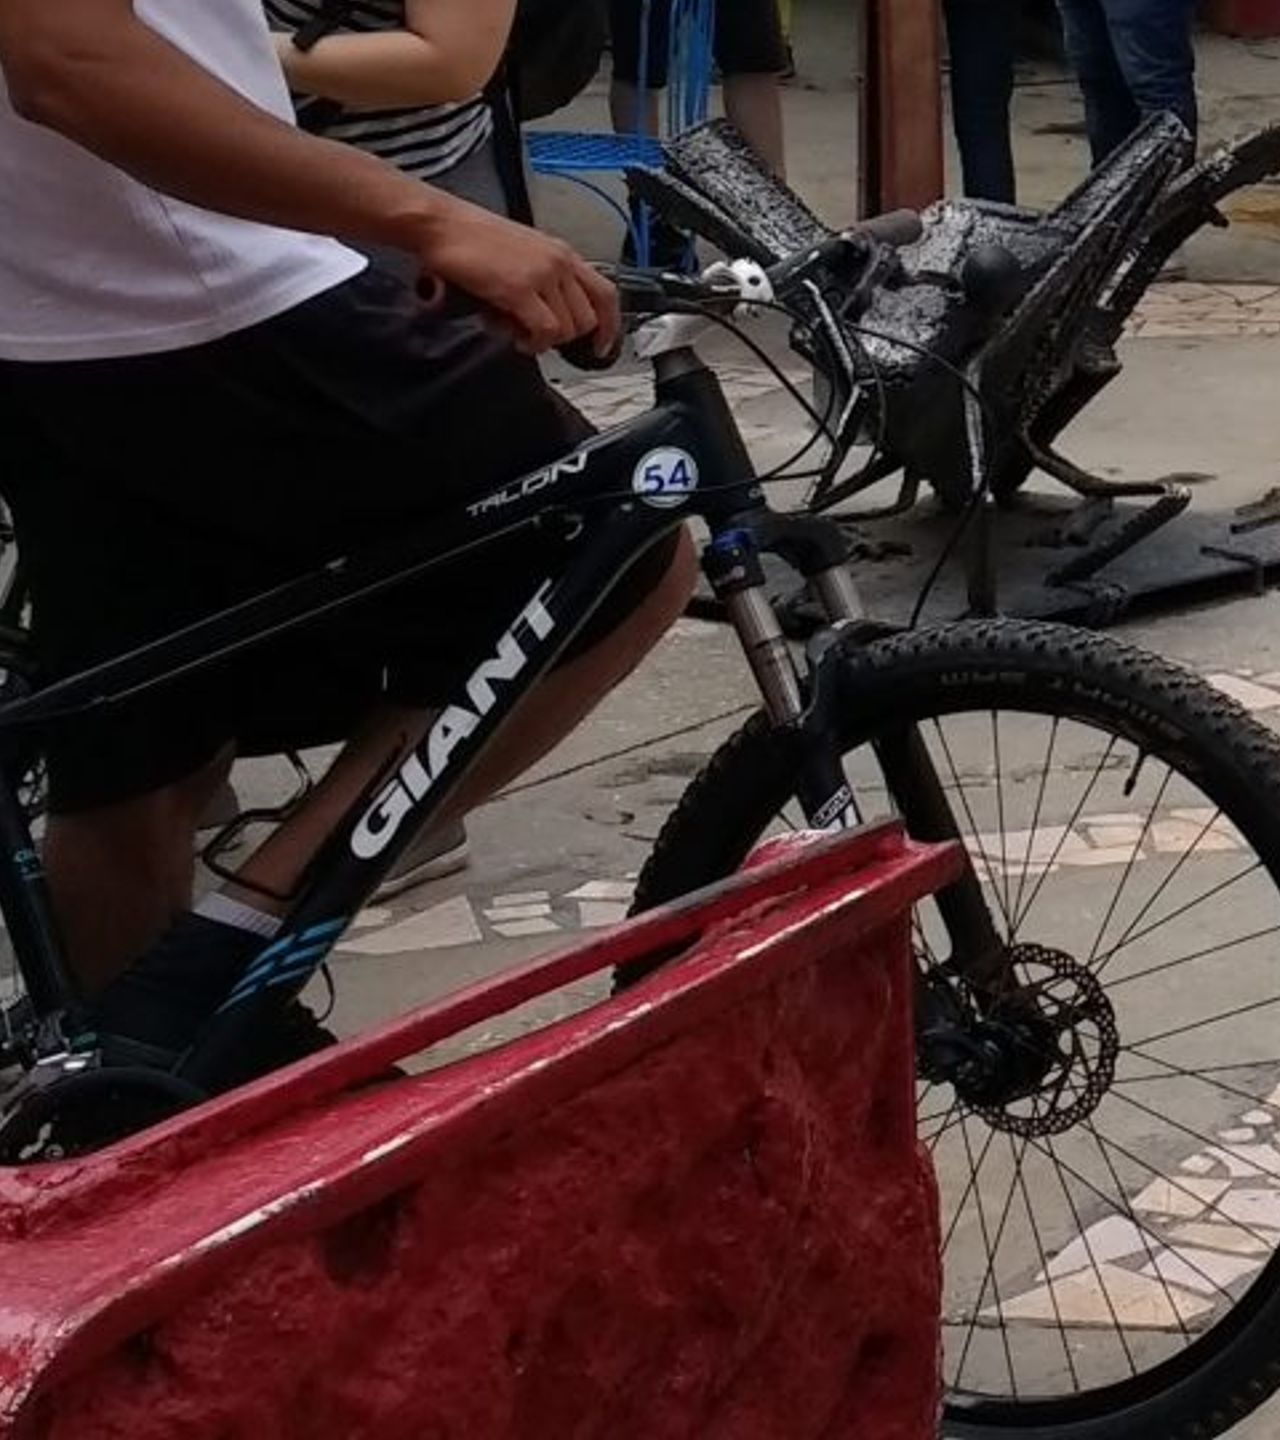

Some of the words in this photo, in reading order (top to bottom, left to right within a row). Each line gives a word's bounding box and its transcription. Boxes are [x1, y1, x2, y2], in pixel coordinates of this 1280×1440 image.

[466, 450, 589, 517] TALON
[643, 457, 692, 494] 54
[349, 578, 558, 860] GIANT
